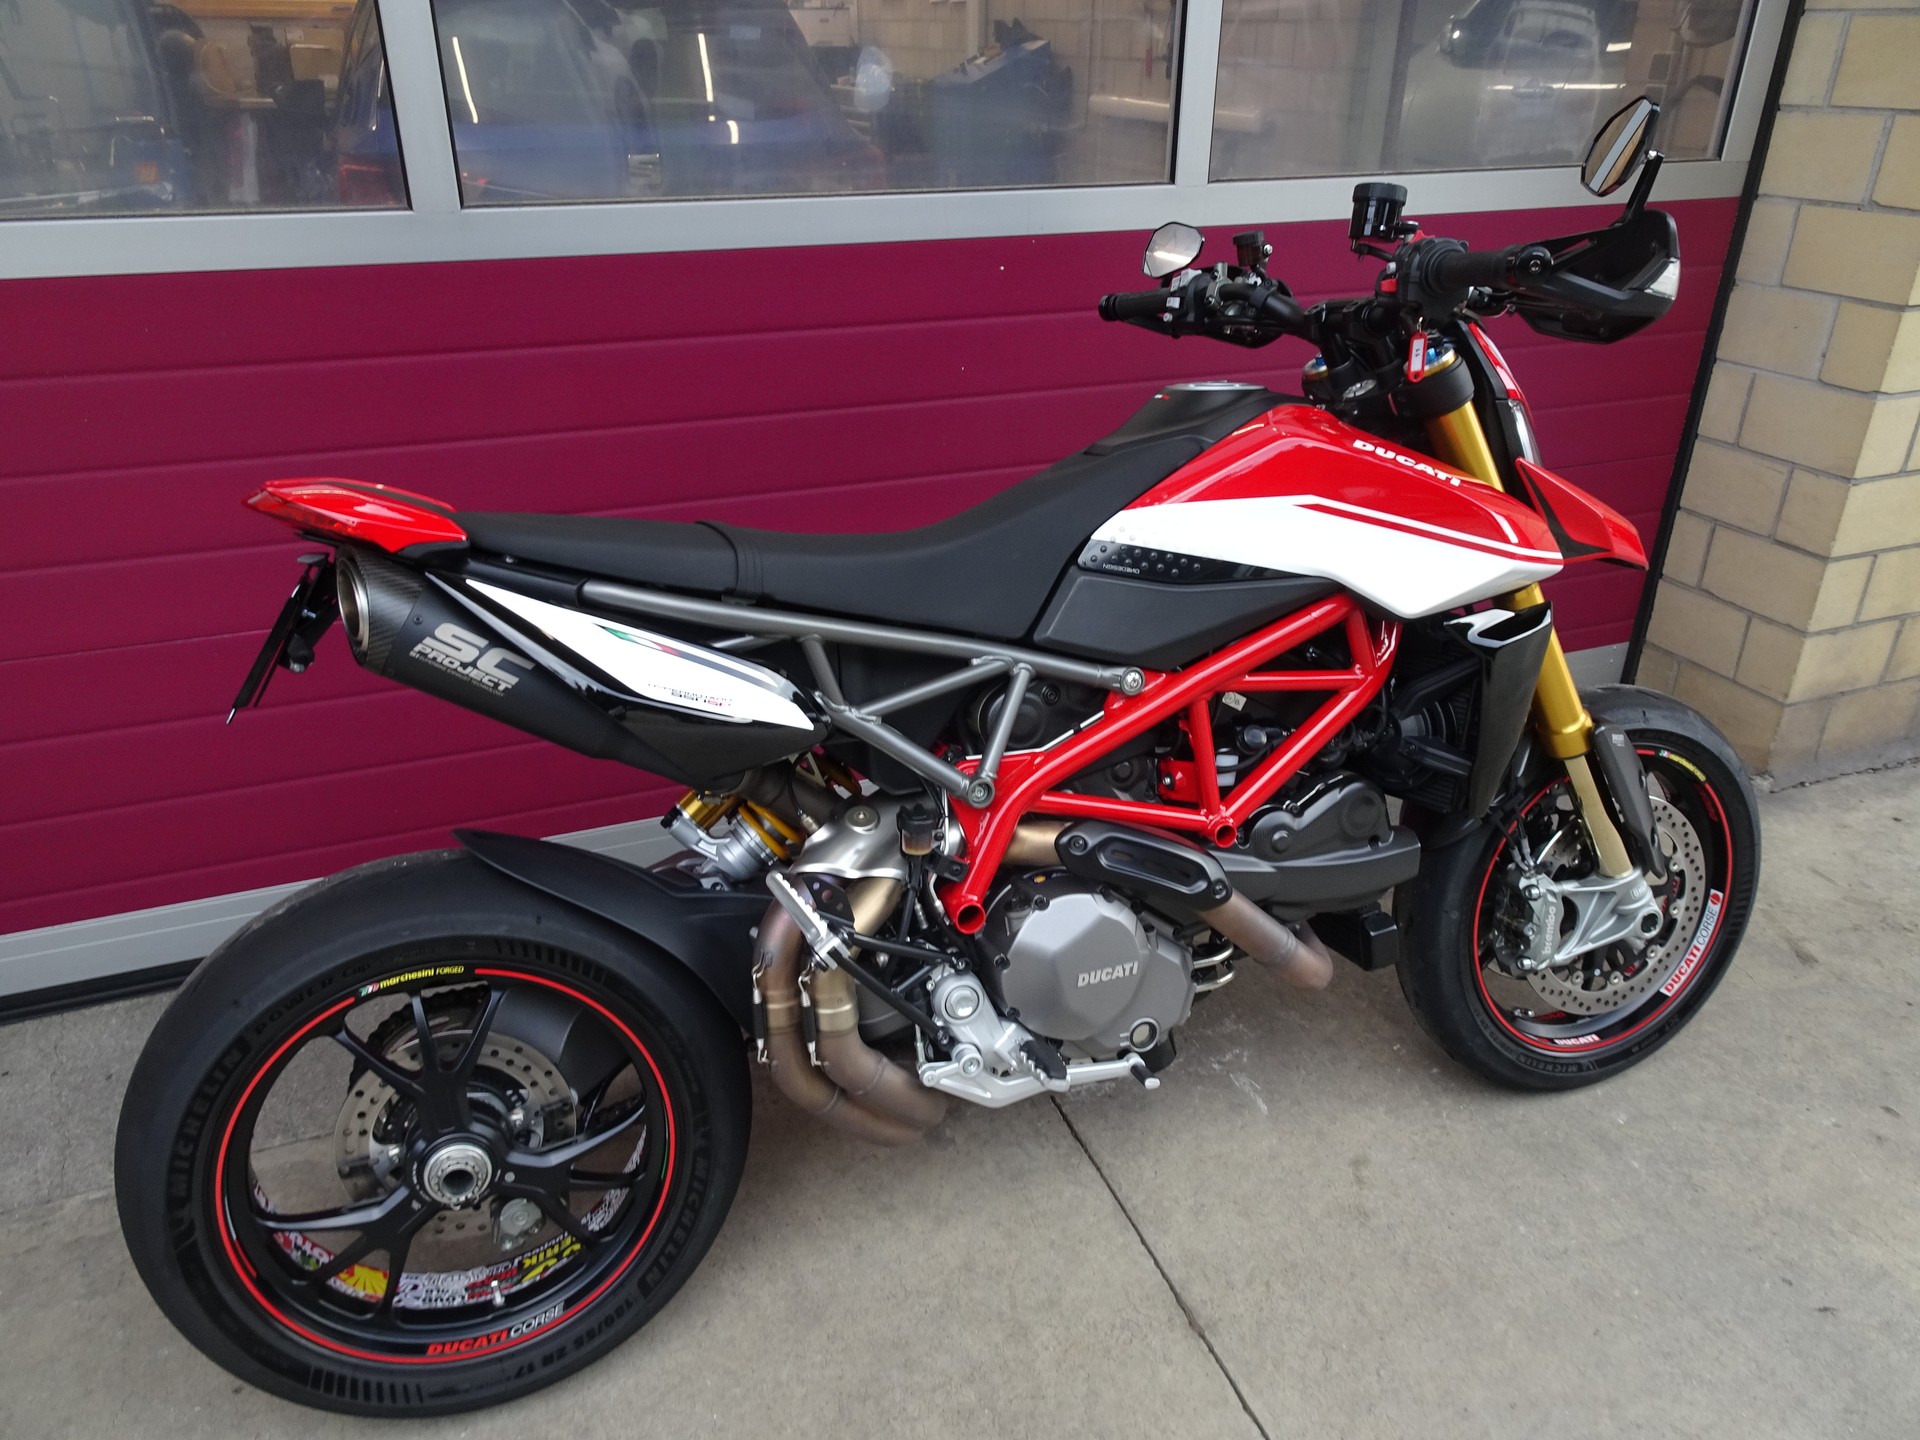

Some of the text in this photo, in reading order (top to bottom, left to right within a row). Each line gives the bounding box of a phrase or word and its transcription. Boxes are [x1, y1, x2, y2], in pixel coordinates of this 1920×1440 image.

[1353, 439, 1461, 487] DUCATI
[412, 642, 512, 692] PROJECT
[422, 622, 536, 686] SC
[1541, 905, 1557, 956] brembo
[1664, 907, 1718, 994] DUCATI CORSE
[380, 965, 465, 990] marchesini FORGED
[1077, 960, 1139, 988] DUCATI
[1553, 1033, 1601, 1046] DUCATI
[171, 1046, 243, 1198] MICHELIN
[644, 1157, 708, 1287] MICHELIN
[426, 1301, 566, 1356] DUCATI CORSE
